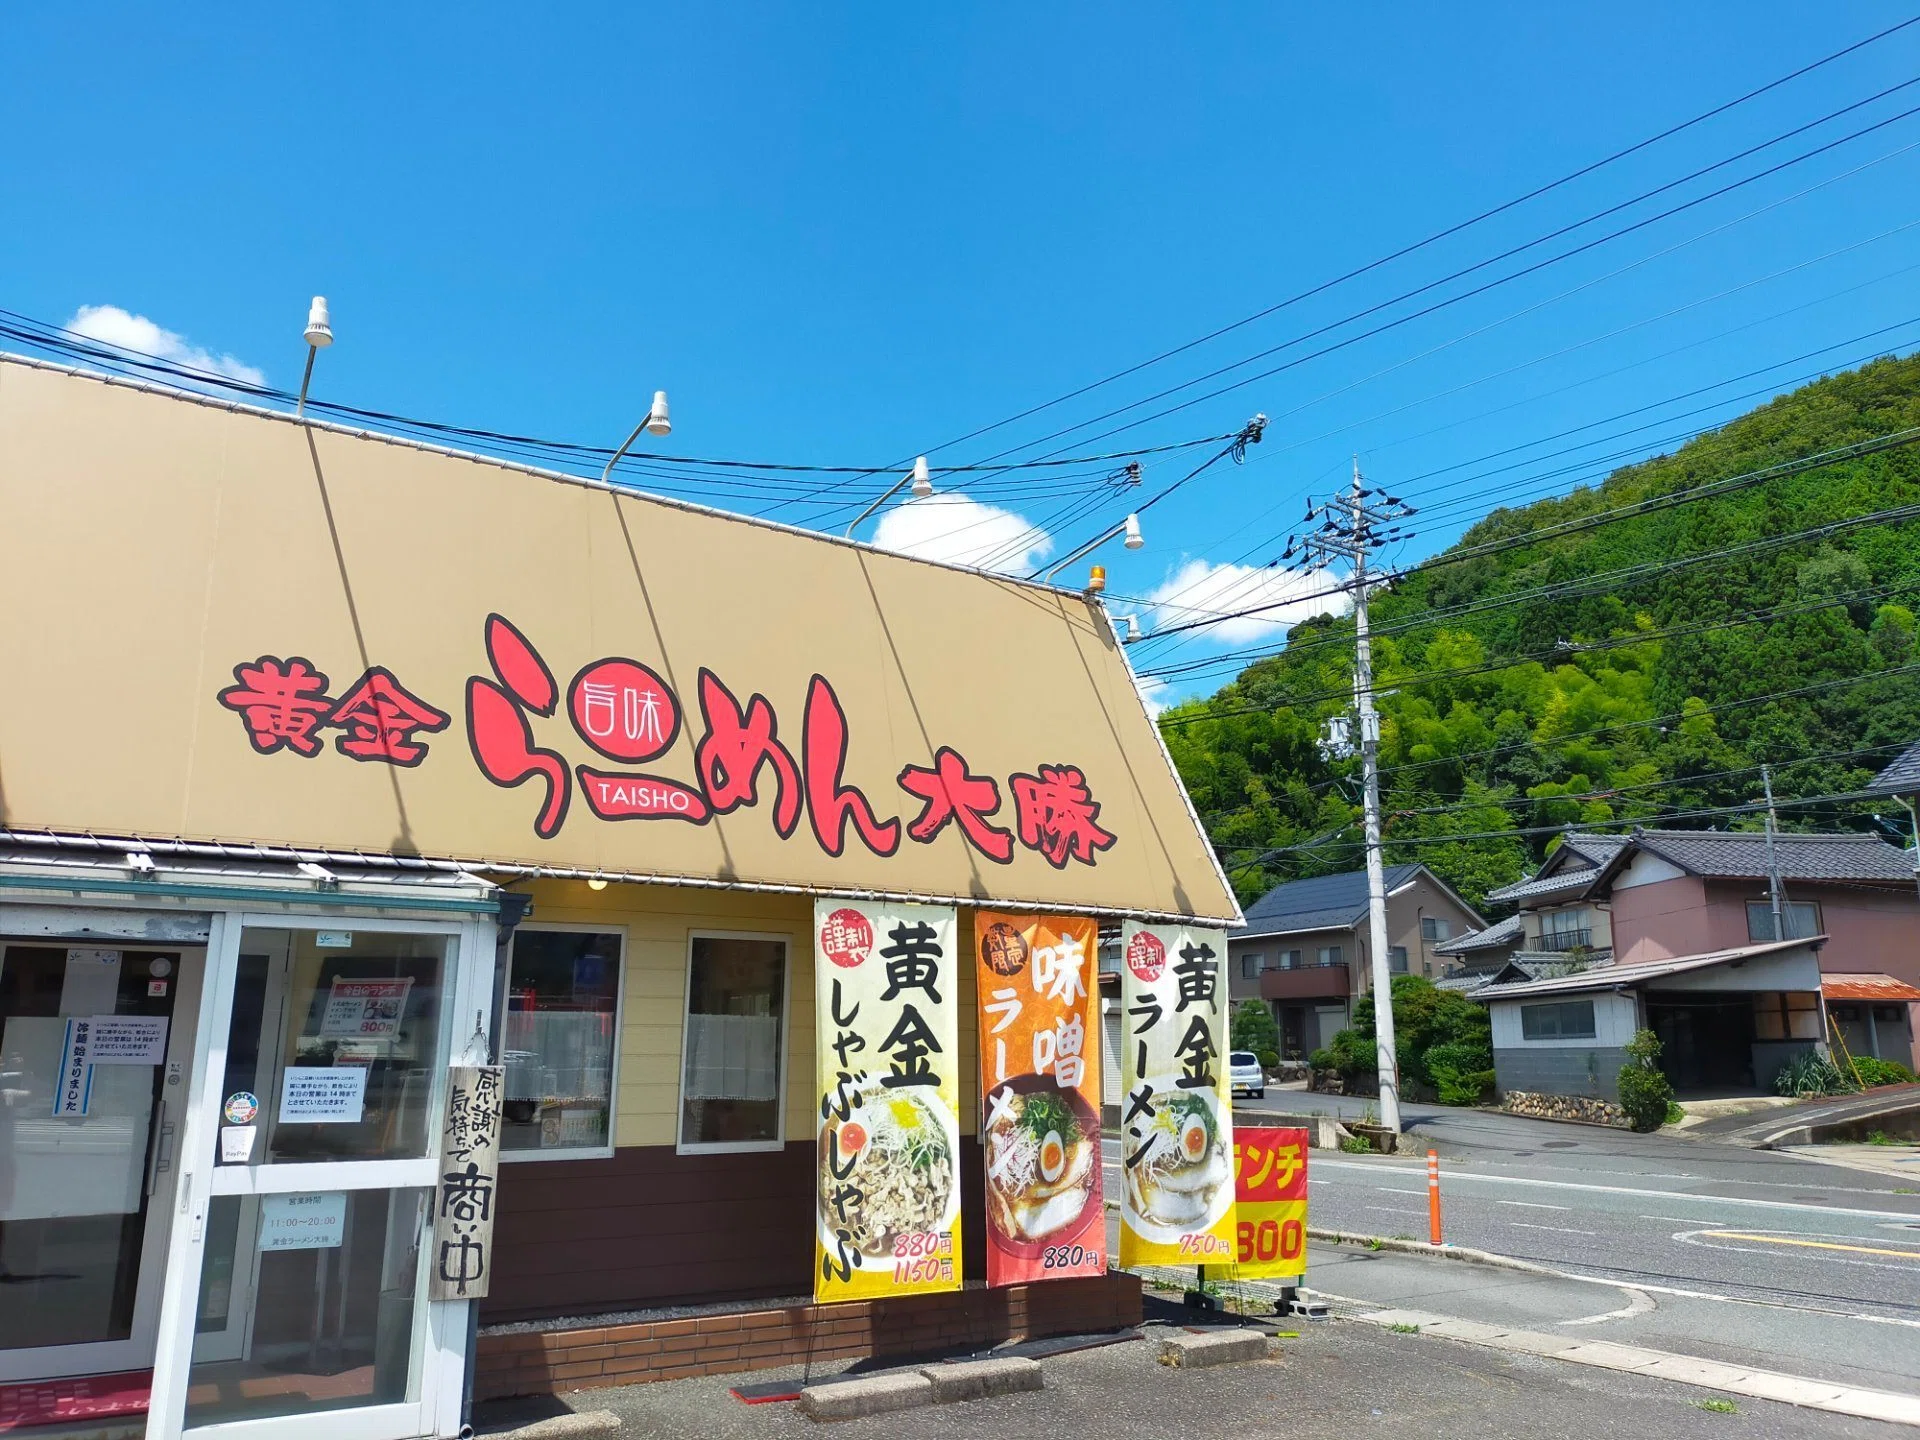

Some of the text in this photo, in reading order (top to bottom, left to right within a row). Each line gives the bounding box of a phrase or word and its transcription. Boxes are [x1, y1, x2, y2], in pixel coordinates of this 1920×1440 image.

[583, 680, 665, 744] 旨味
[597, 782, 689, 813] TAISHO
[878, 921, 944, 1087] 黄金
[1032, 932, 1087, 1089] 味噌
[1173, 941, 1218, 1089] 黄金
[471, 1067, 502, 1149] 感謝の
[984, 987, 1023, 1180] ラーメン
[1124, 993, 1163, 1169] ラーメン
[444, 1084, 475, 1163] 気持ちで
[822, 978, 867, 1283] しゃぶしゃぶ
[440, 1163, 494, 1295] 商い中
[895, 1231, 952, 1258] 880円
[1043, 1245, 1098, 1269] 880円
[1179, 1233, 1230, 1255] 750円
[894, 1258, 953, 1283] 1150円
